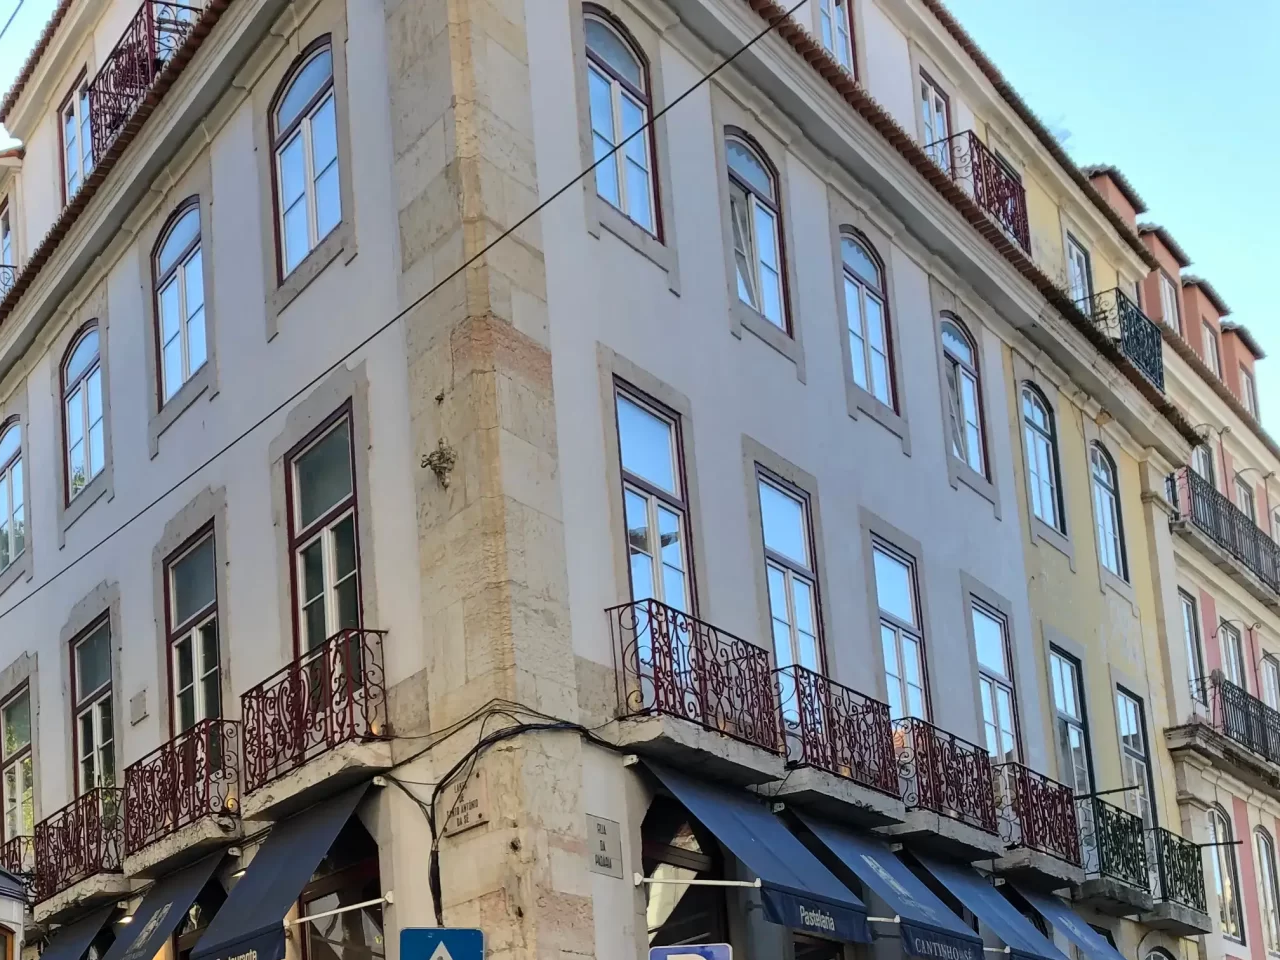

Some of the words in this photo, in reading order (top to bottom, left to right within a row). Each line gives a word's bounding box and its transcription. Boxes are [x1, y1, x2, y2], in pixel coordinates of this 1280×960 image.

[597, 823, 607, 835] RUA
[800, 905, 835, 931] Pastelaria
[915, 938, 960, 960] CANTINHO
